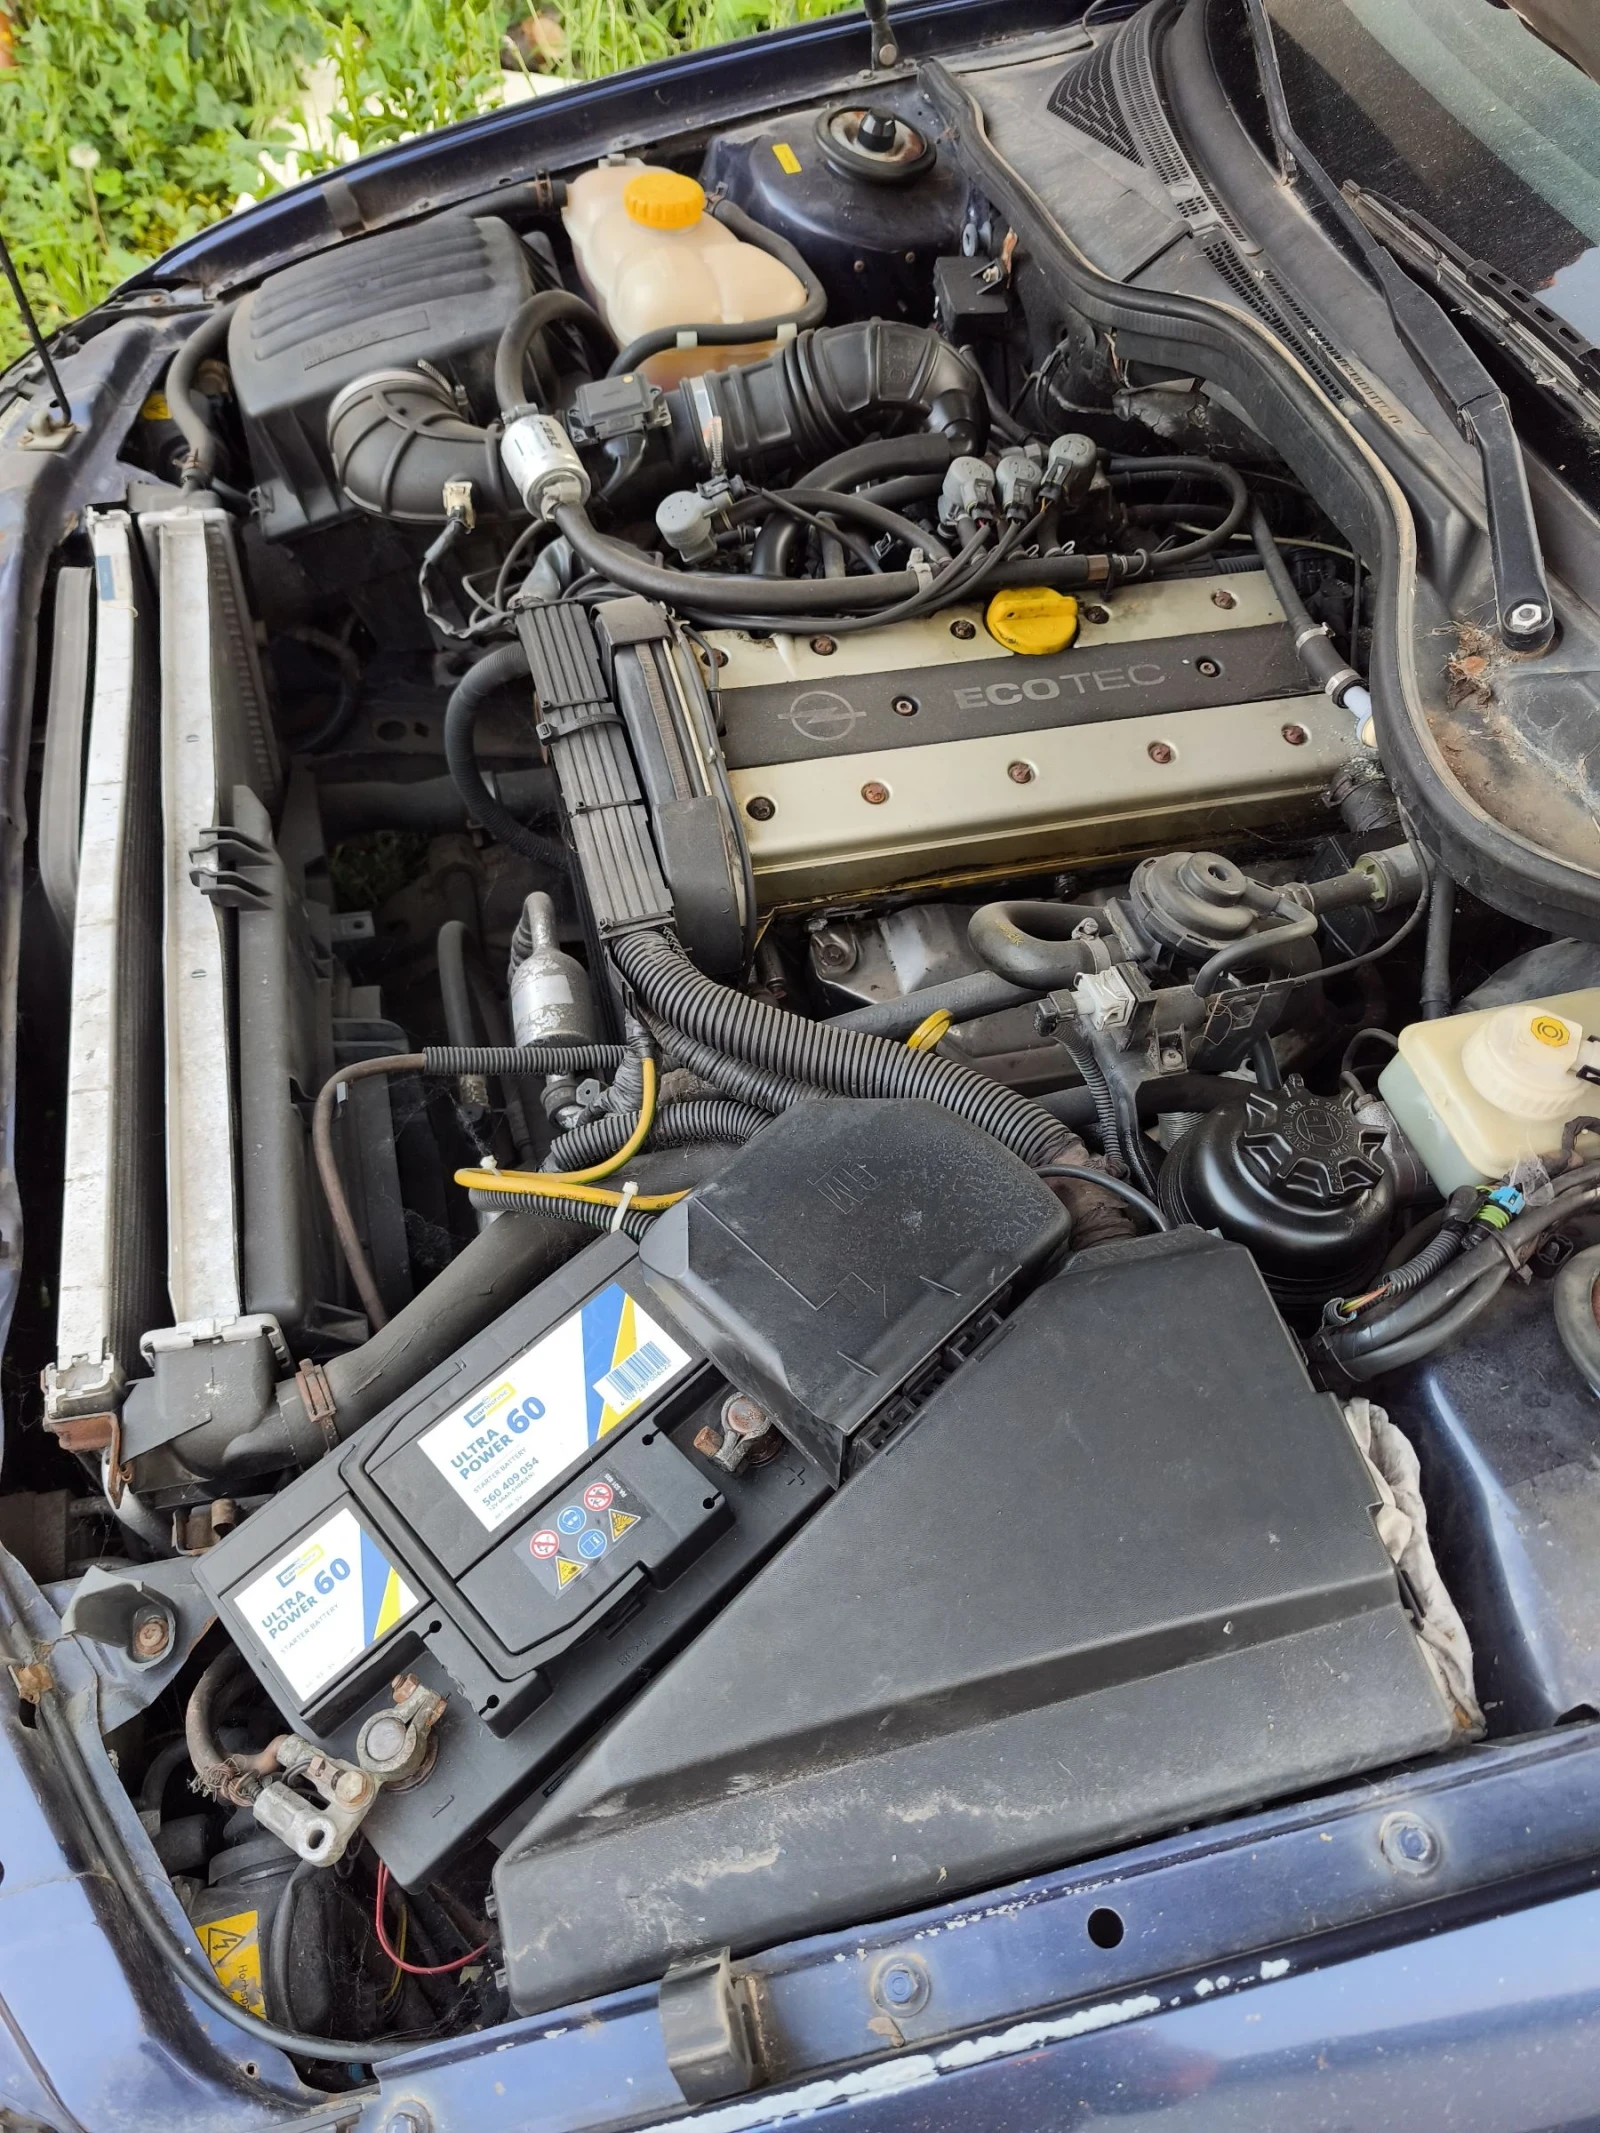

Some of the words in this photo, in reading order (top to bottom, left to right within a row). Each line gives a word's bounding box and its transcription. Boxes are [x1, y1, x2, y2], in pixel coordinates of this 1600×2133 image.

[953, 663, 1166, 711] ECOTEC
[1284, 1100, 1307, 1118] LEVEL
[450, 1428, 500, 1468] ULTRA
[506, 1396, 546, 1434] 60
[459, 1434, 514, 1480] POWER
[473, 1467, 502, 1494] STARTER
[500, 1446, 527, 1472] BATTERY
[482, 1488, 502, 1507] 560
[502, 1472, 521, 1491] 409
[519, 1456, 540, 1475] 054
[261, 1589, 307, 1629] ULTRA
[314, 1557, 351, 1595] 60
[268, 1595, 319, 1640] POWER
[280, 1627, 310, 1655] STARTER
[310, 1603, 340, 1630] BATTERY
